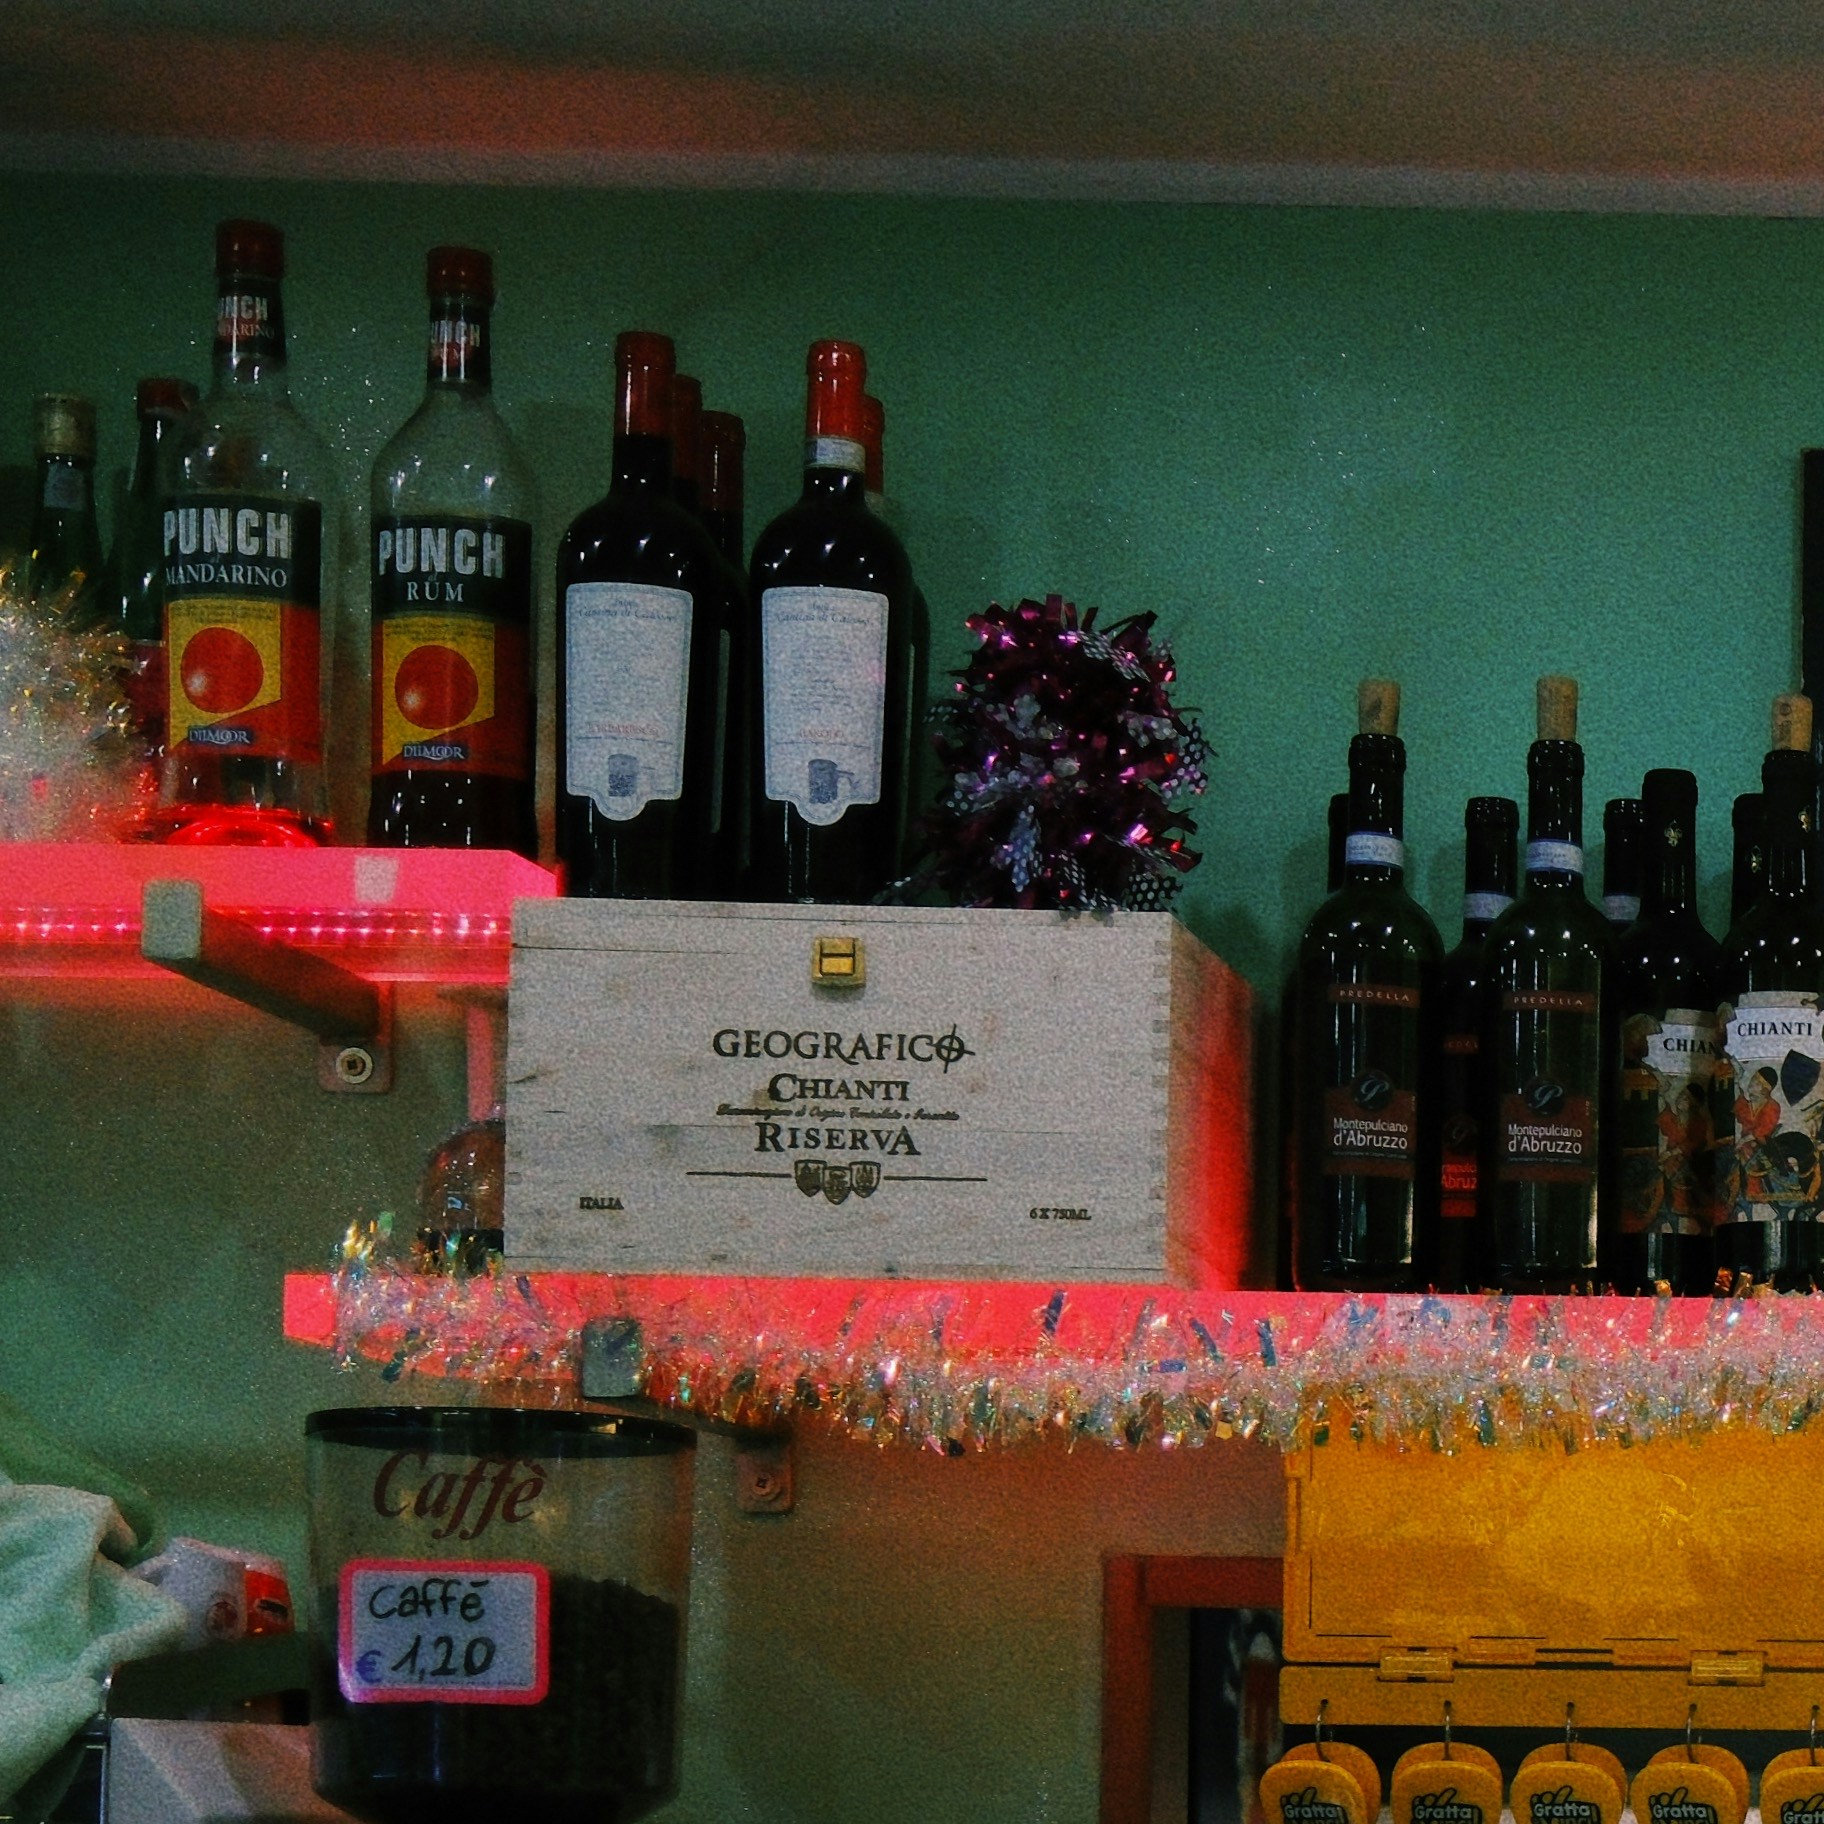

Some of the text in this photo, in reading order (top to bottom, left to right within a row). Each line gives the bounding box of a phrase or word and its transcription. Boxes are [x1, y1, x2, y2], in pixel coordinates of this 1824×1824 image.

[163, 507, 292, 558] PUNCH
[379, 527, 506, 579] PUNCH
[165, 563, 288, 588] MANDARINO
[407, 581, 464, 602] RUM
[1339, 989, 1411, 1002] PREDELLA
[1736, 1018, 1814, 1041] CHIANTI
[712, 1025, 975, 1070] GEOGRAFICO
[767, 1072, 910, 1102] CHIANTI
[1332, 1117, 1408, 1134] Montepulciano
[1507, 1122, 1583, 1139] Montepulciano
[754, 1121, 921, 1156] RISERVA
[1332, 1130, 1408, 1151] d'Abruzzo
[1507, 1136, 1583, 1155] d'Abruzzo
[579, 1196, 624, 1211] ITALIA
[1029, 1207, 1038, 1220] 6
[372, 1447, 549, 1541] Caffè
[356, 1634, 497, 1684] € 1,20
[1414, 1803, 1472, 1820] Gratta
[1533, 1802, 1591, 1818] Gratta
[1652, 1803, 1707, 1819] Gratta
